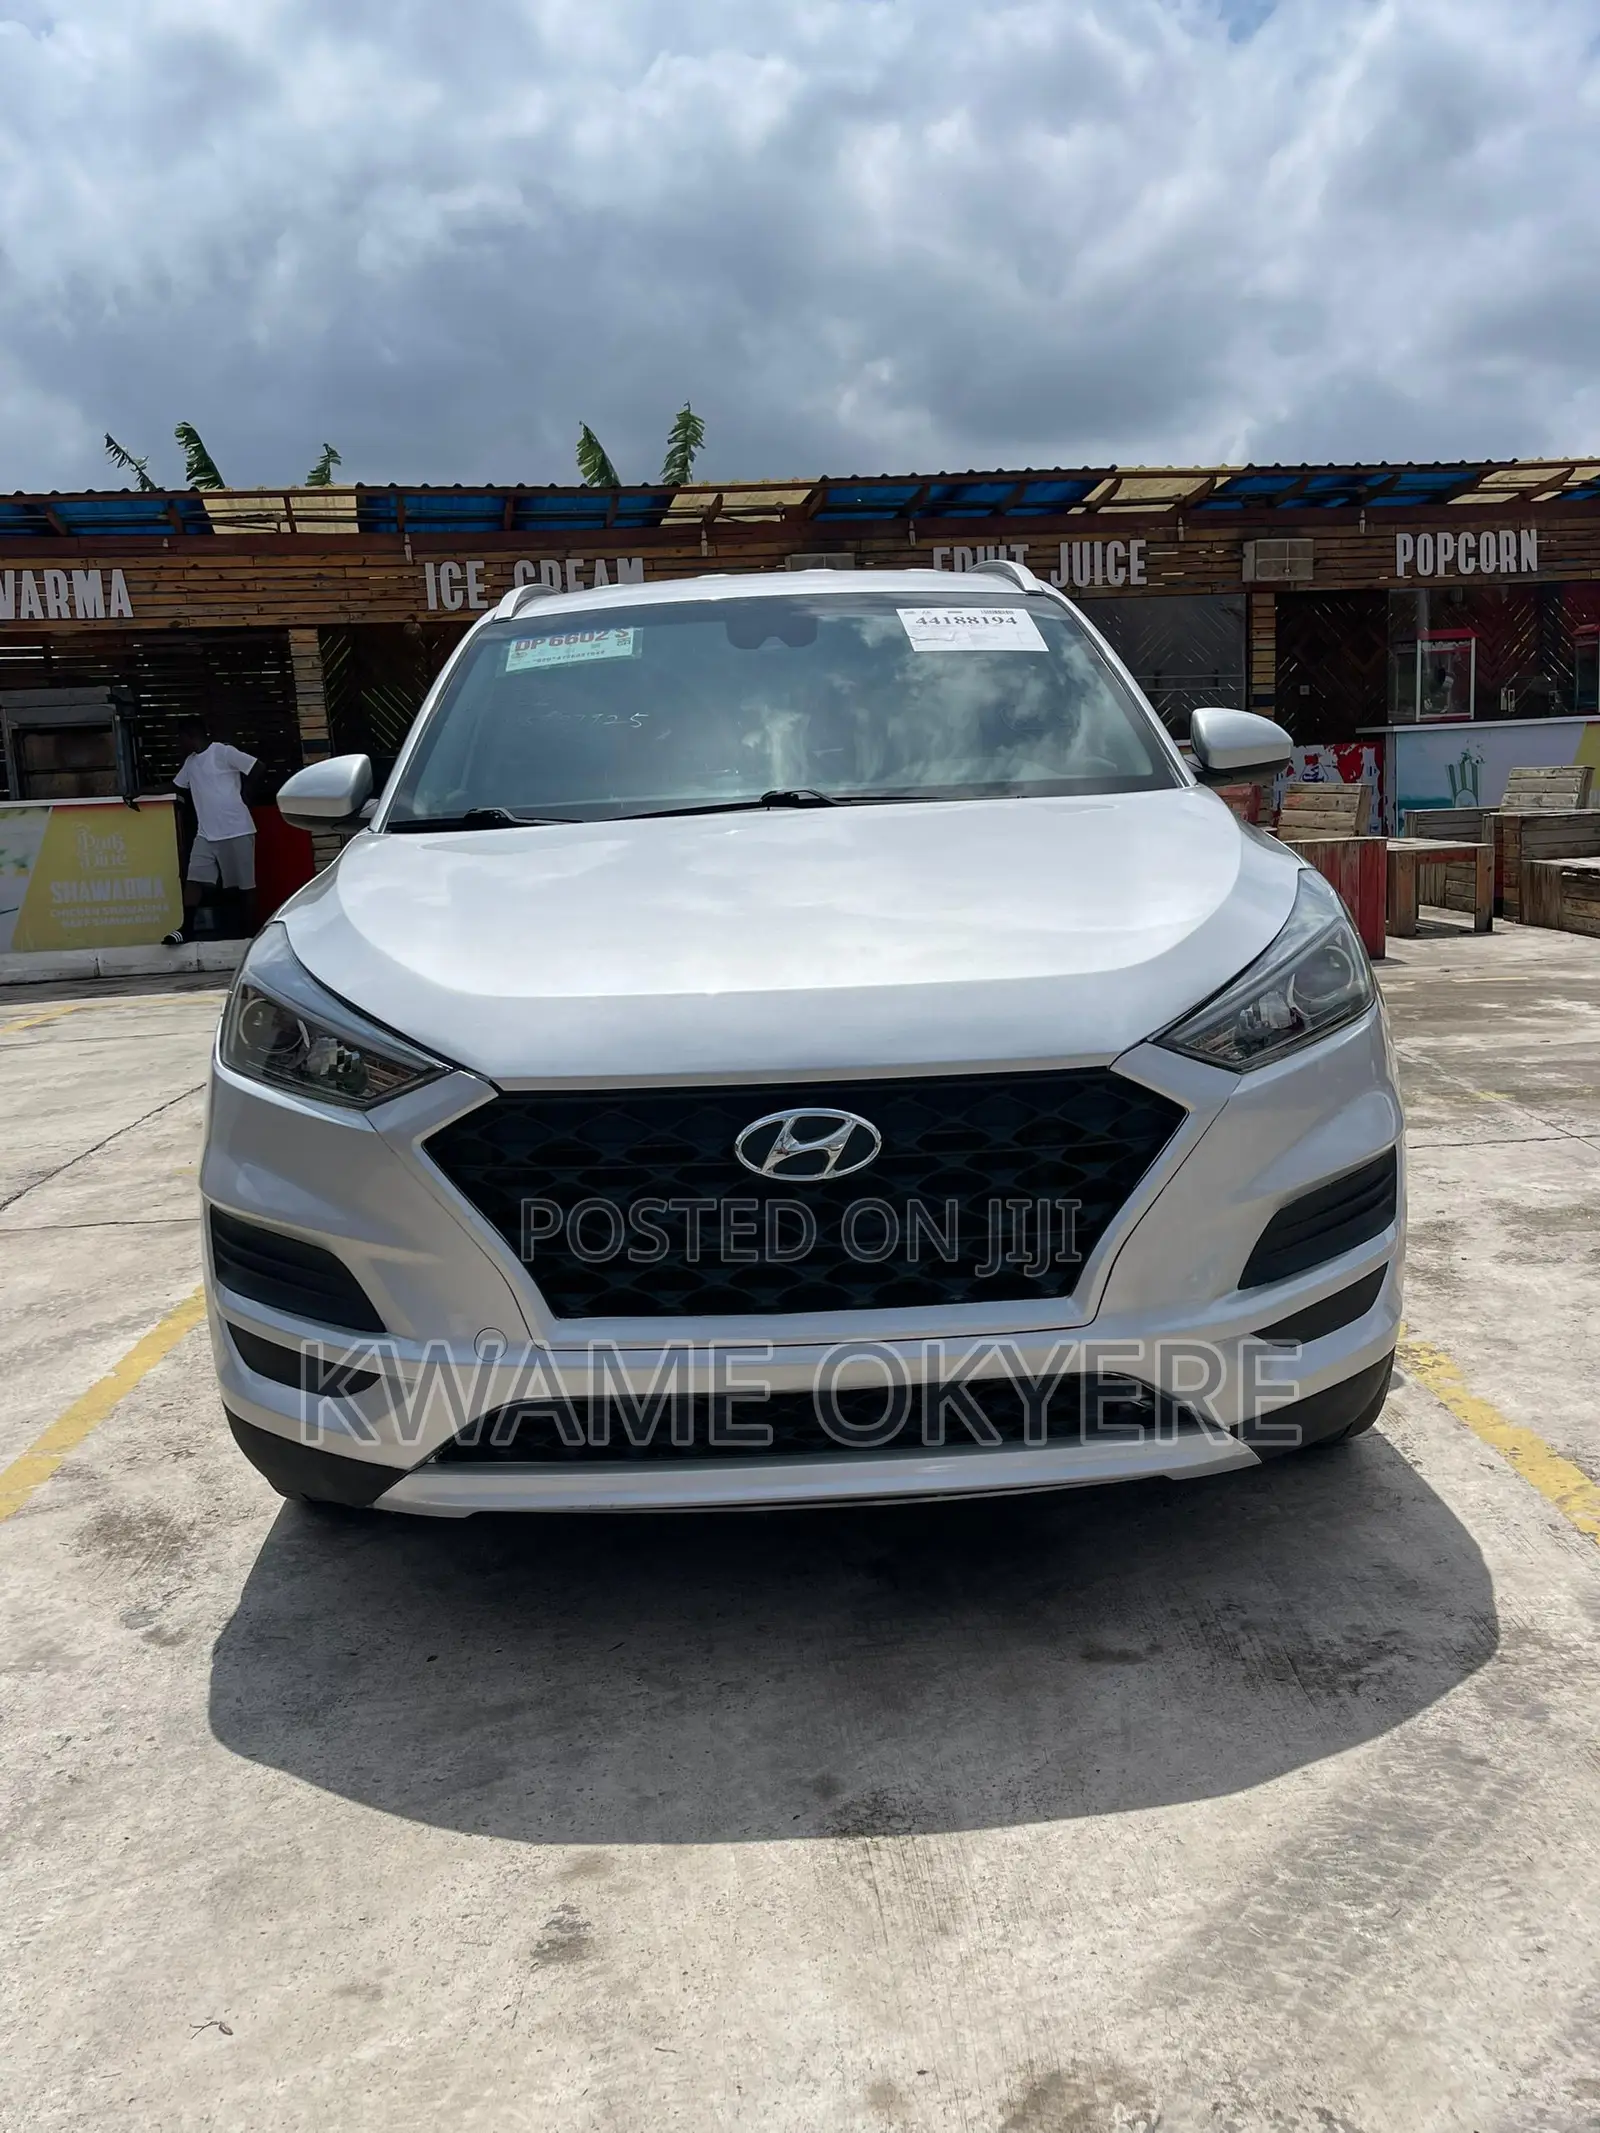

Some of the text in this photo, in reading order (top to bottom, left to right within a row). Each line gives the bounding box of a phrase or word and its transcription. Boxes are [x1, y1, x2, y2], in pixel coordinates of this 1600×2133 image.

[1051, 538, 1149, 589] JUICE
[1395, 528, 1538, 577] POPCORN
[425, 559, 489, 611] ICE
[915, 616, 1018, 626] 44188194
